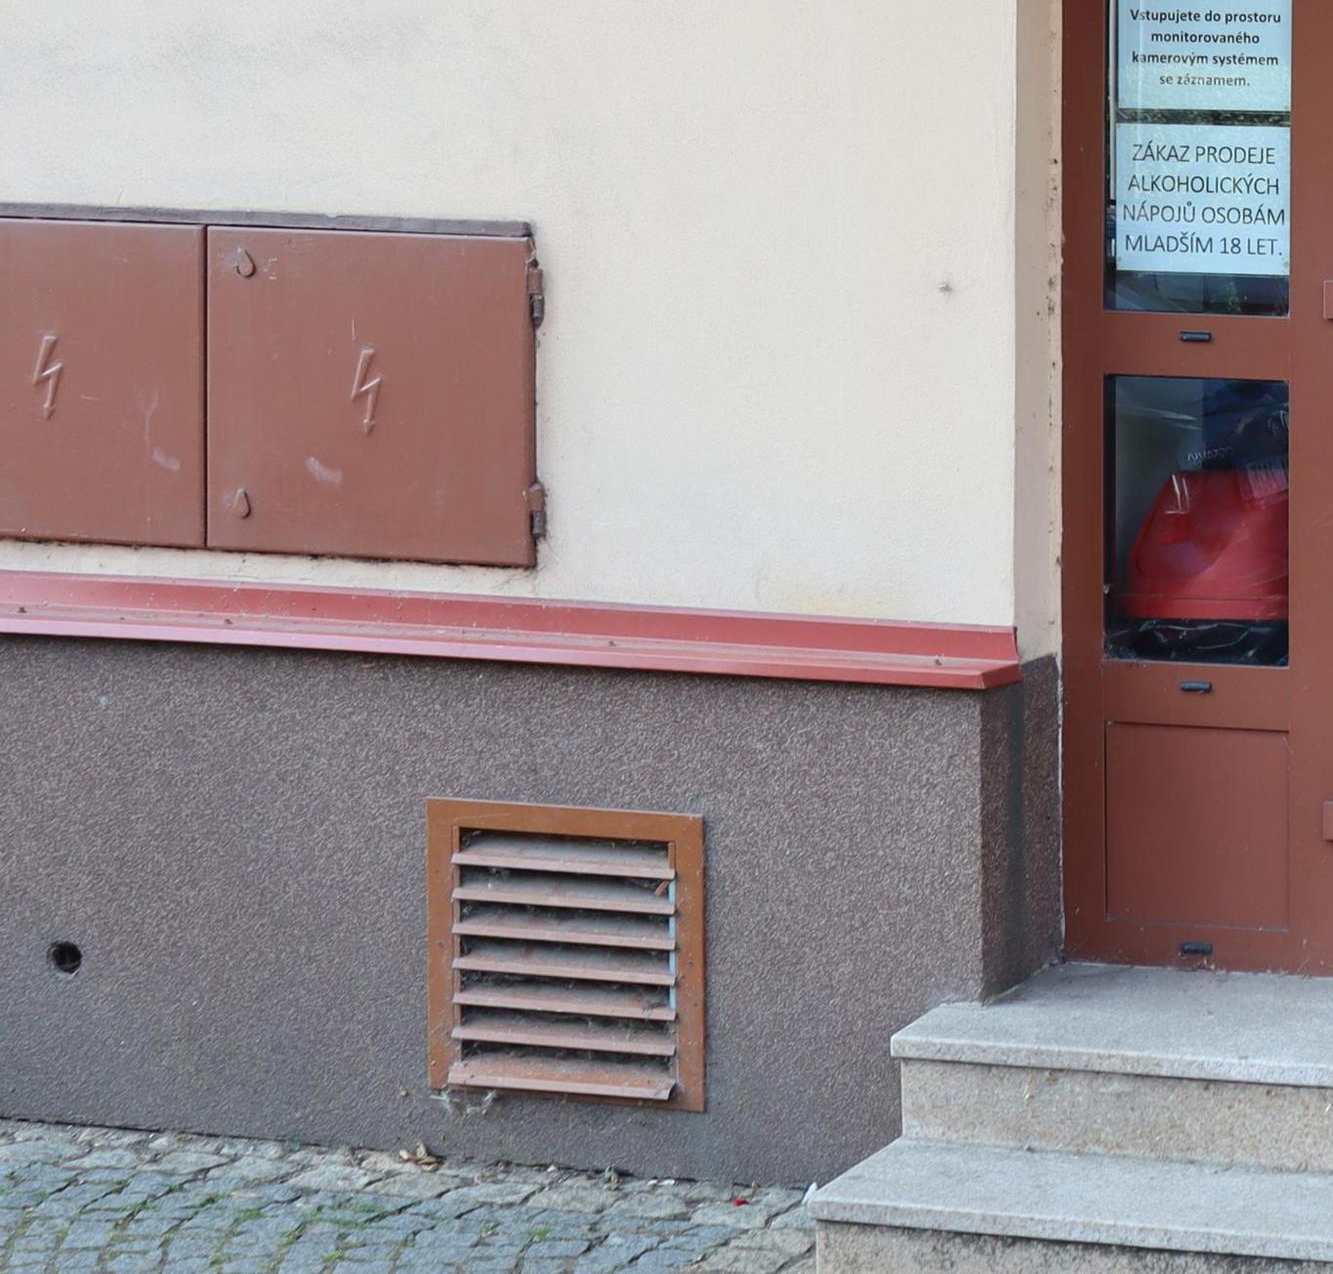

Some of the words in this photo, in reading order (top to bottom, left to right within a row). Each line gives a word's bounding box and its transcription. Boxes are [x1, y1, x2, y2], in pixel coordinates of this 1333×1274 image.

[1130, 9, 1200, 23] Vstupujete
[1205, 10, 1221, 22] do
[1225, 12, 1281, 24] prostoru
[1152, 31, 1259, 44] monitorovaného
[1132, 51, 1208, 66] kamerovým
[1212, 53, 1278, 67] systémem
[1160, 75, 1173, 84] se
[1177, 74, 1250, 86] záznamem.
[1132, 141, 1190, 162] ZÁKAZ
[1196, 146, 1276, 164] PRODEJE
[1128, 173, 1279, 195] ALKOHOLICKÝCH
[1123, 201, 1195, 222] NÁPOJŮ
[1202, 205, 1285, 225] OSOBÁM
[1125, 232, 1213, 253] MLADŠÍM
[1220, 238, 1241, 254] 18
[1248, 238, 1282, 256] LET.
